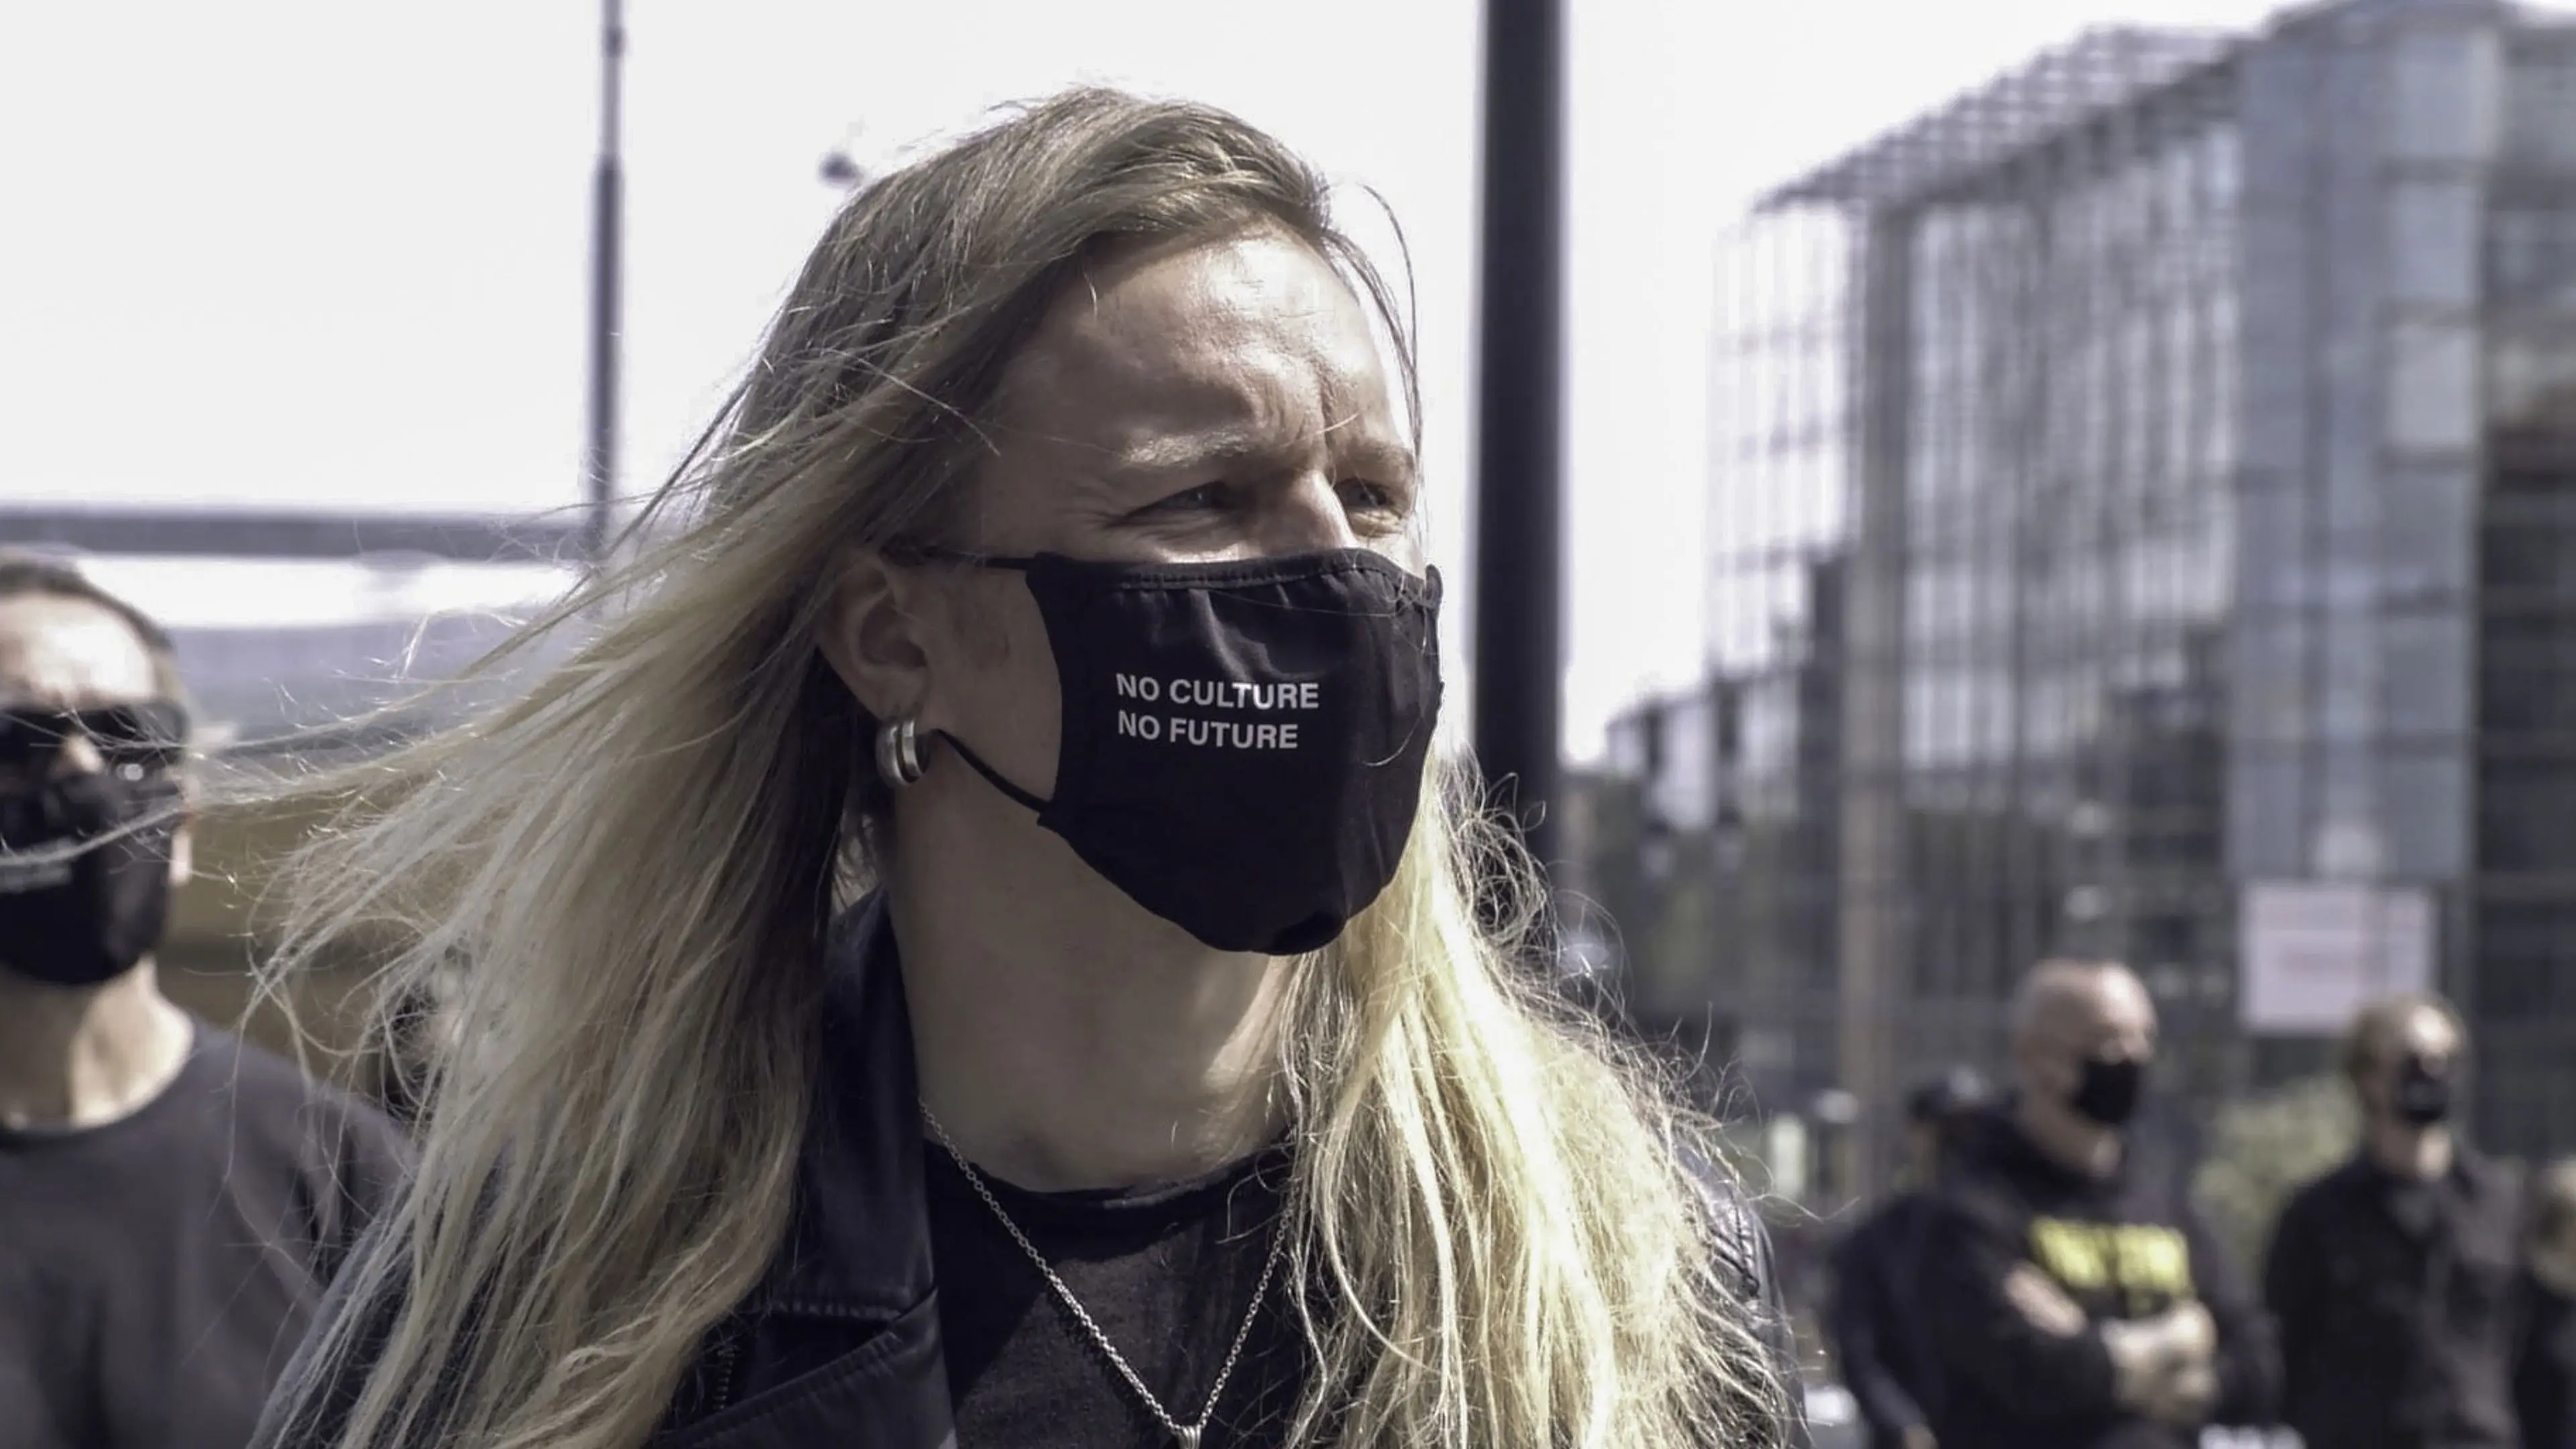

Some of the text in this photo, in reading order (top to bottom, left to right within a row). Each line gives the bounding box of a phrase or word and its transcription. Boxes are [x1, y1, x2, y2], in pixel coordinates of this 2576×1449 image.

[1116, 673, 1320, 710] NO CULTURE
[1118, 710, 1299, 749] NO FUTURE
